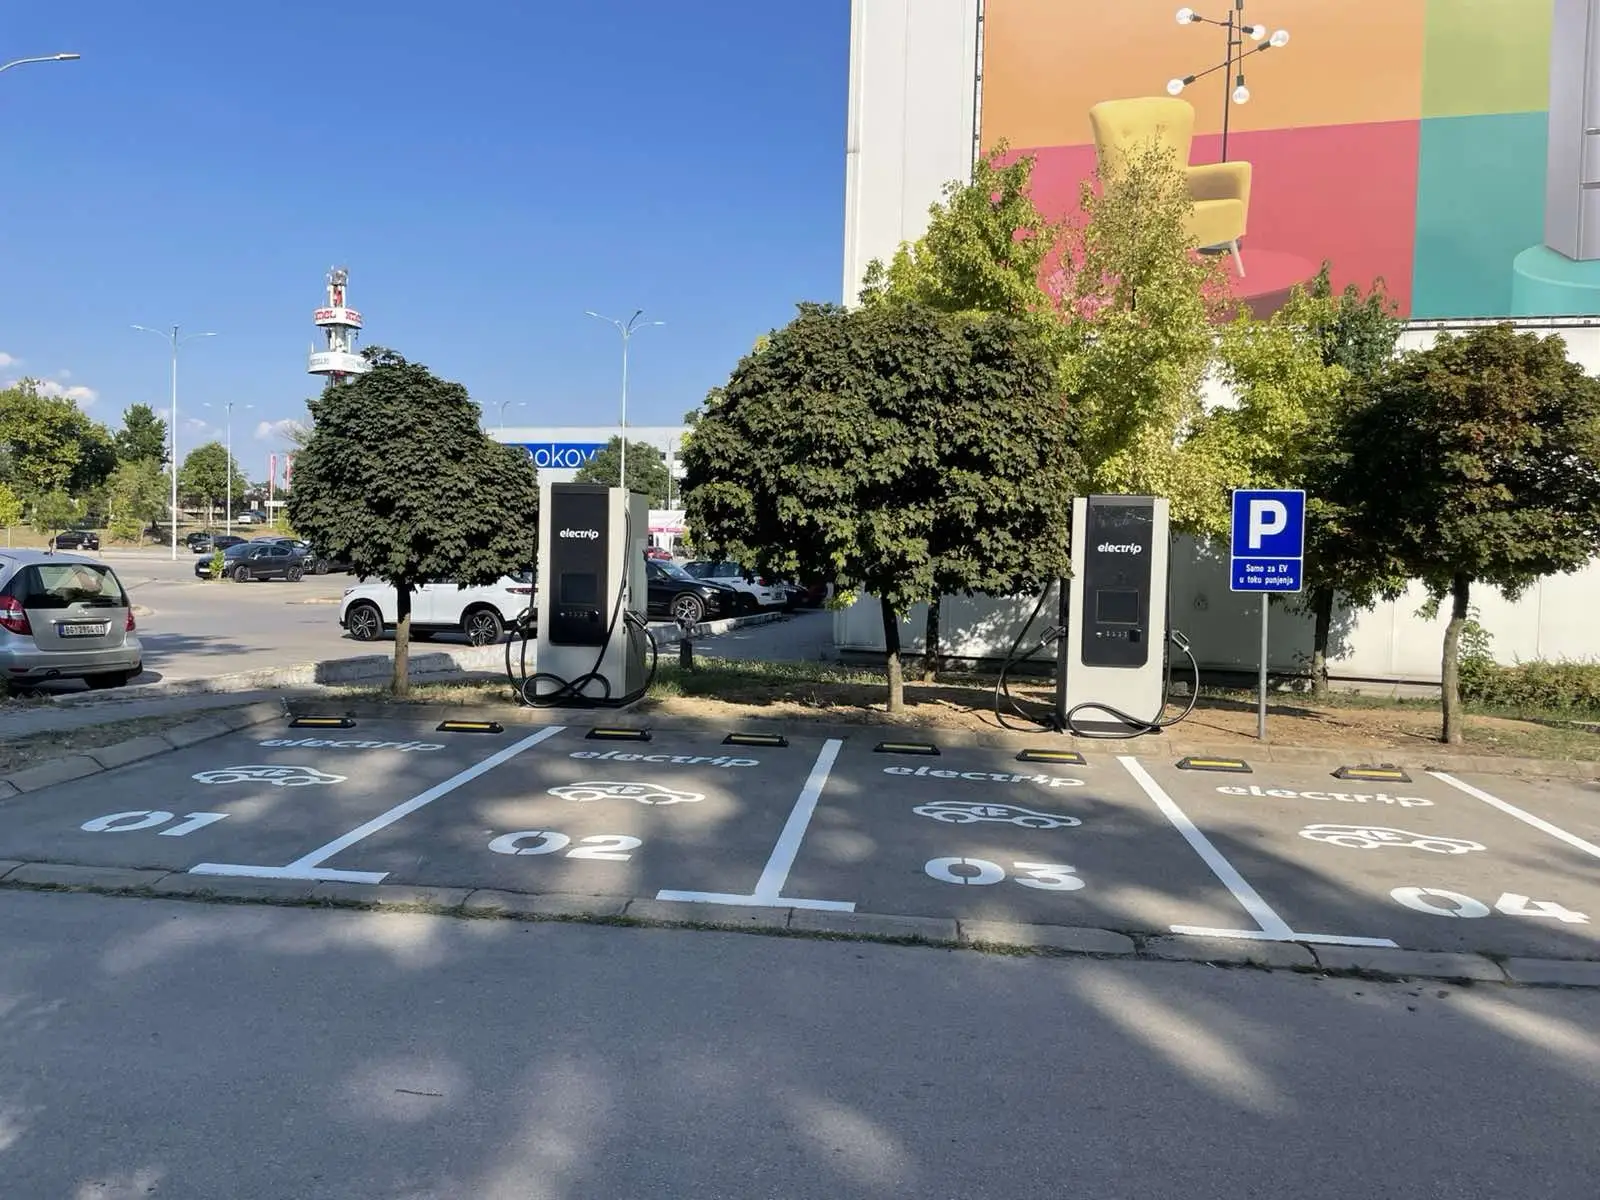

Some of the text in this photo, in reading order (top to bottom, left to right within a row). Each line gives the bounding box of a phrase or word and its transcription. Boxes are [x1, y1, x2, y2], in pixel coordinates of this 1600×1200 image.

[559, 528, 599, 541] electrip
[1248, 499, 1288, 549] P
[1097, 542, 1142, 554] electrip
[1245, 564, 1288, 573] Samo za EV
[1264, 576, 1294, 586] punjenja
[259, 737, 447, 753] electrip
[569, 750, 761, 768] electrip
[883, 766, 1085, 787] electrip
[1215, 785, 1435, 808] electrip
[80, 810, 232, 837] 01
[488, 831, 643, 862] 02
[924, 857, 1086, 891] 03
[1390, 886, 1591, 924] 04
